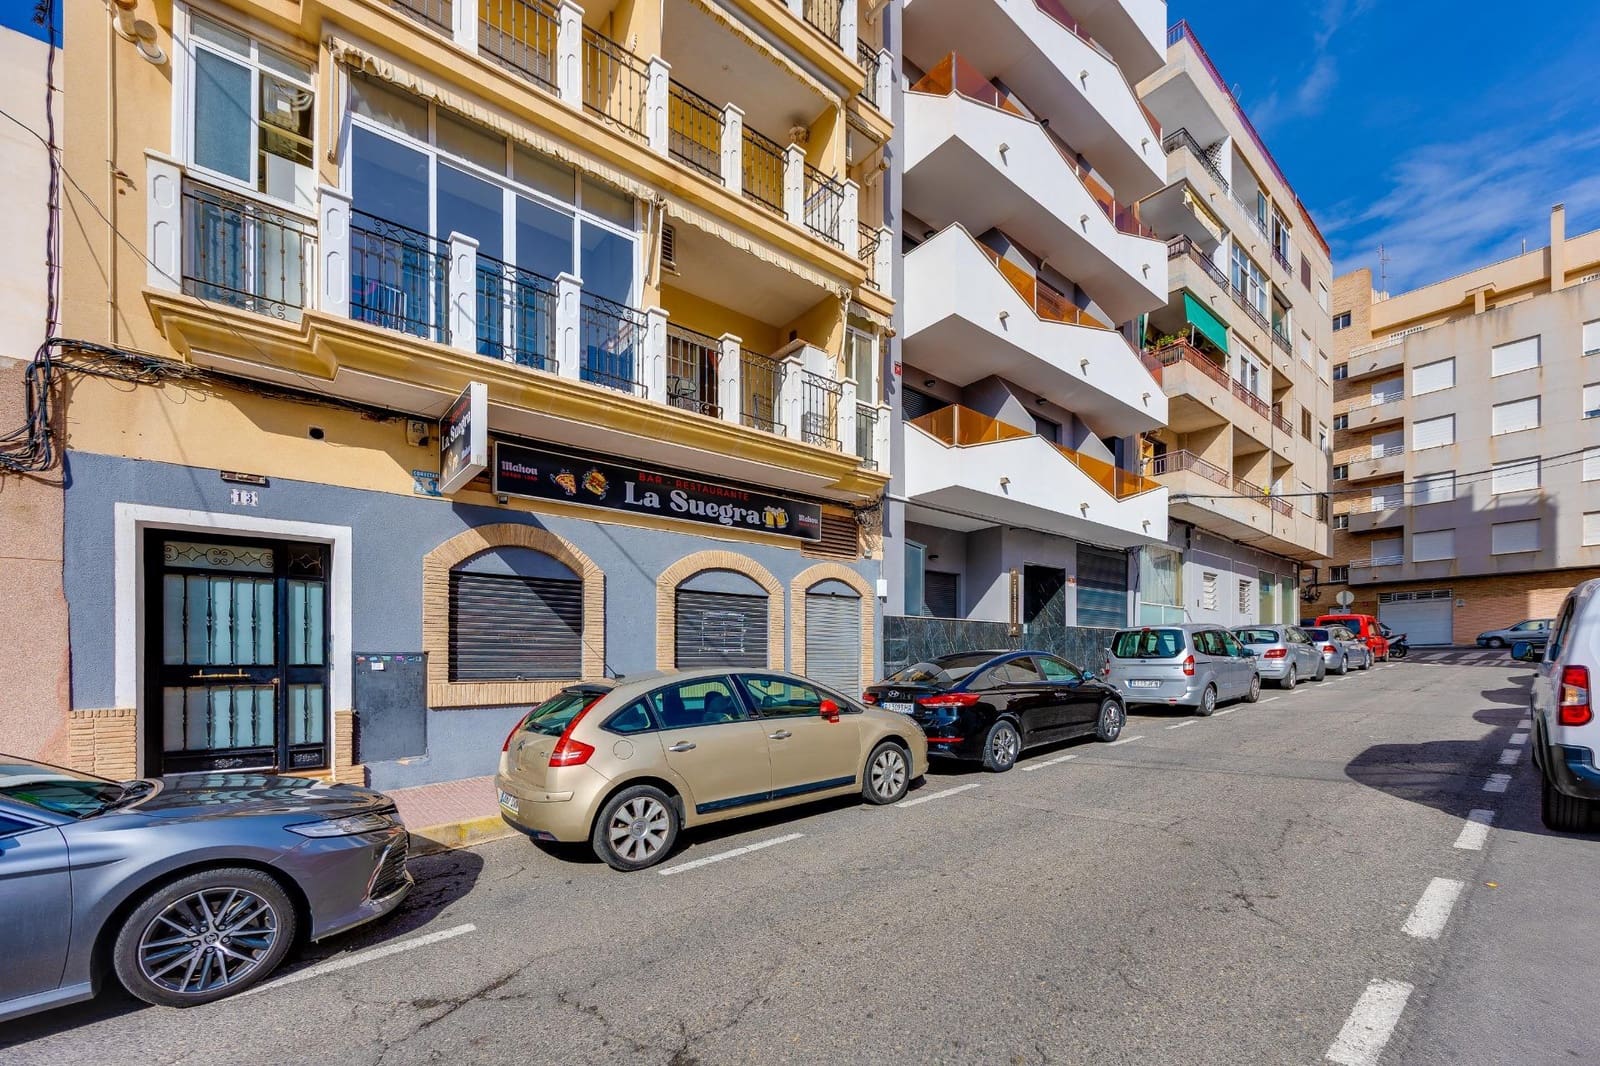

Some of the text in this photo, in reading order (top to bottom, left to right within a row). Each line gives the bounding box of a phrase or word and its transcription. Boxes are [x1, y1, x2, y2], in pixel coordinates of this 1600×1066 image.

[441, 435, 450, 452] La
[501, 461, 538, 475] Mahou
[638, 472, 663, 484] BAR
[675, 480, 749, 501] RESTAURANTE
[237, 491, 253, 504] 13
[624, 481, 761, 526] La Suegra
